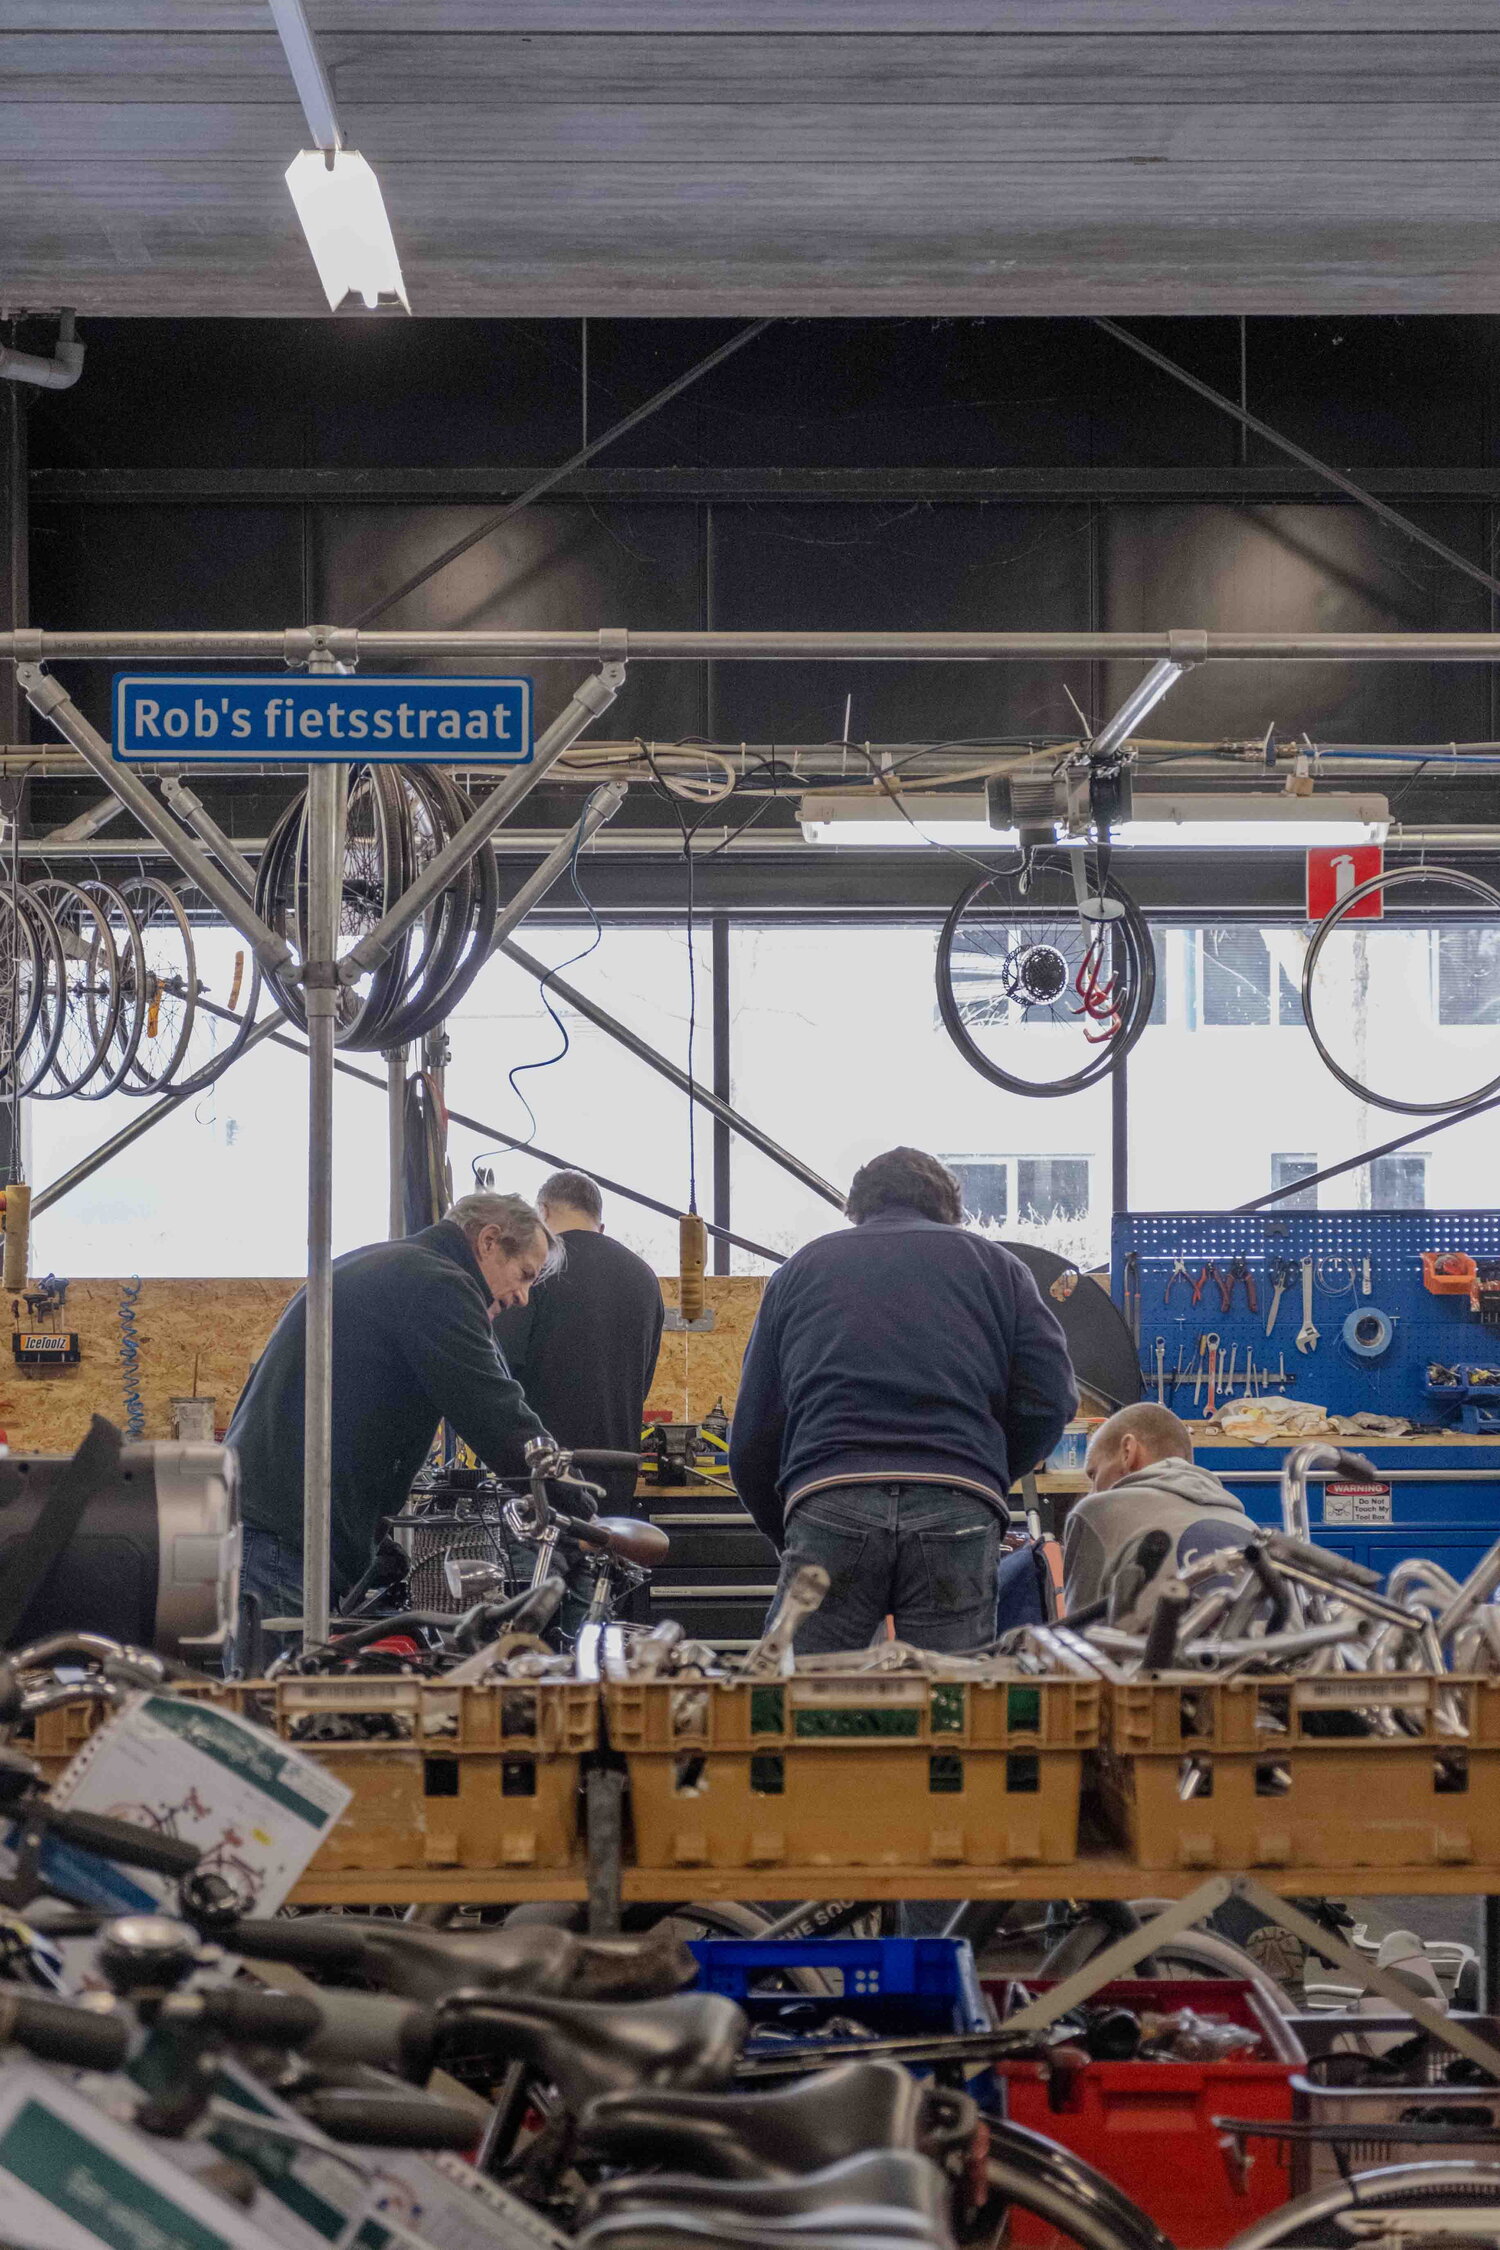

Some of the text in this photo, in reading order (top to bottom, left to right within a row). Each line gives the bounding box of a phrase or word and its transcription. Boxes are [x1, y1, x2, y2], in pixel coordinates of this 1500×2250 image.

[134, 698, 511, 740] Rob's fietsstraat
[25, 1336, 66, 1349] IceToolz
[1378, 1506, 1390, 1514] My
